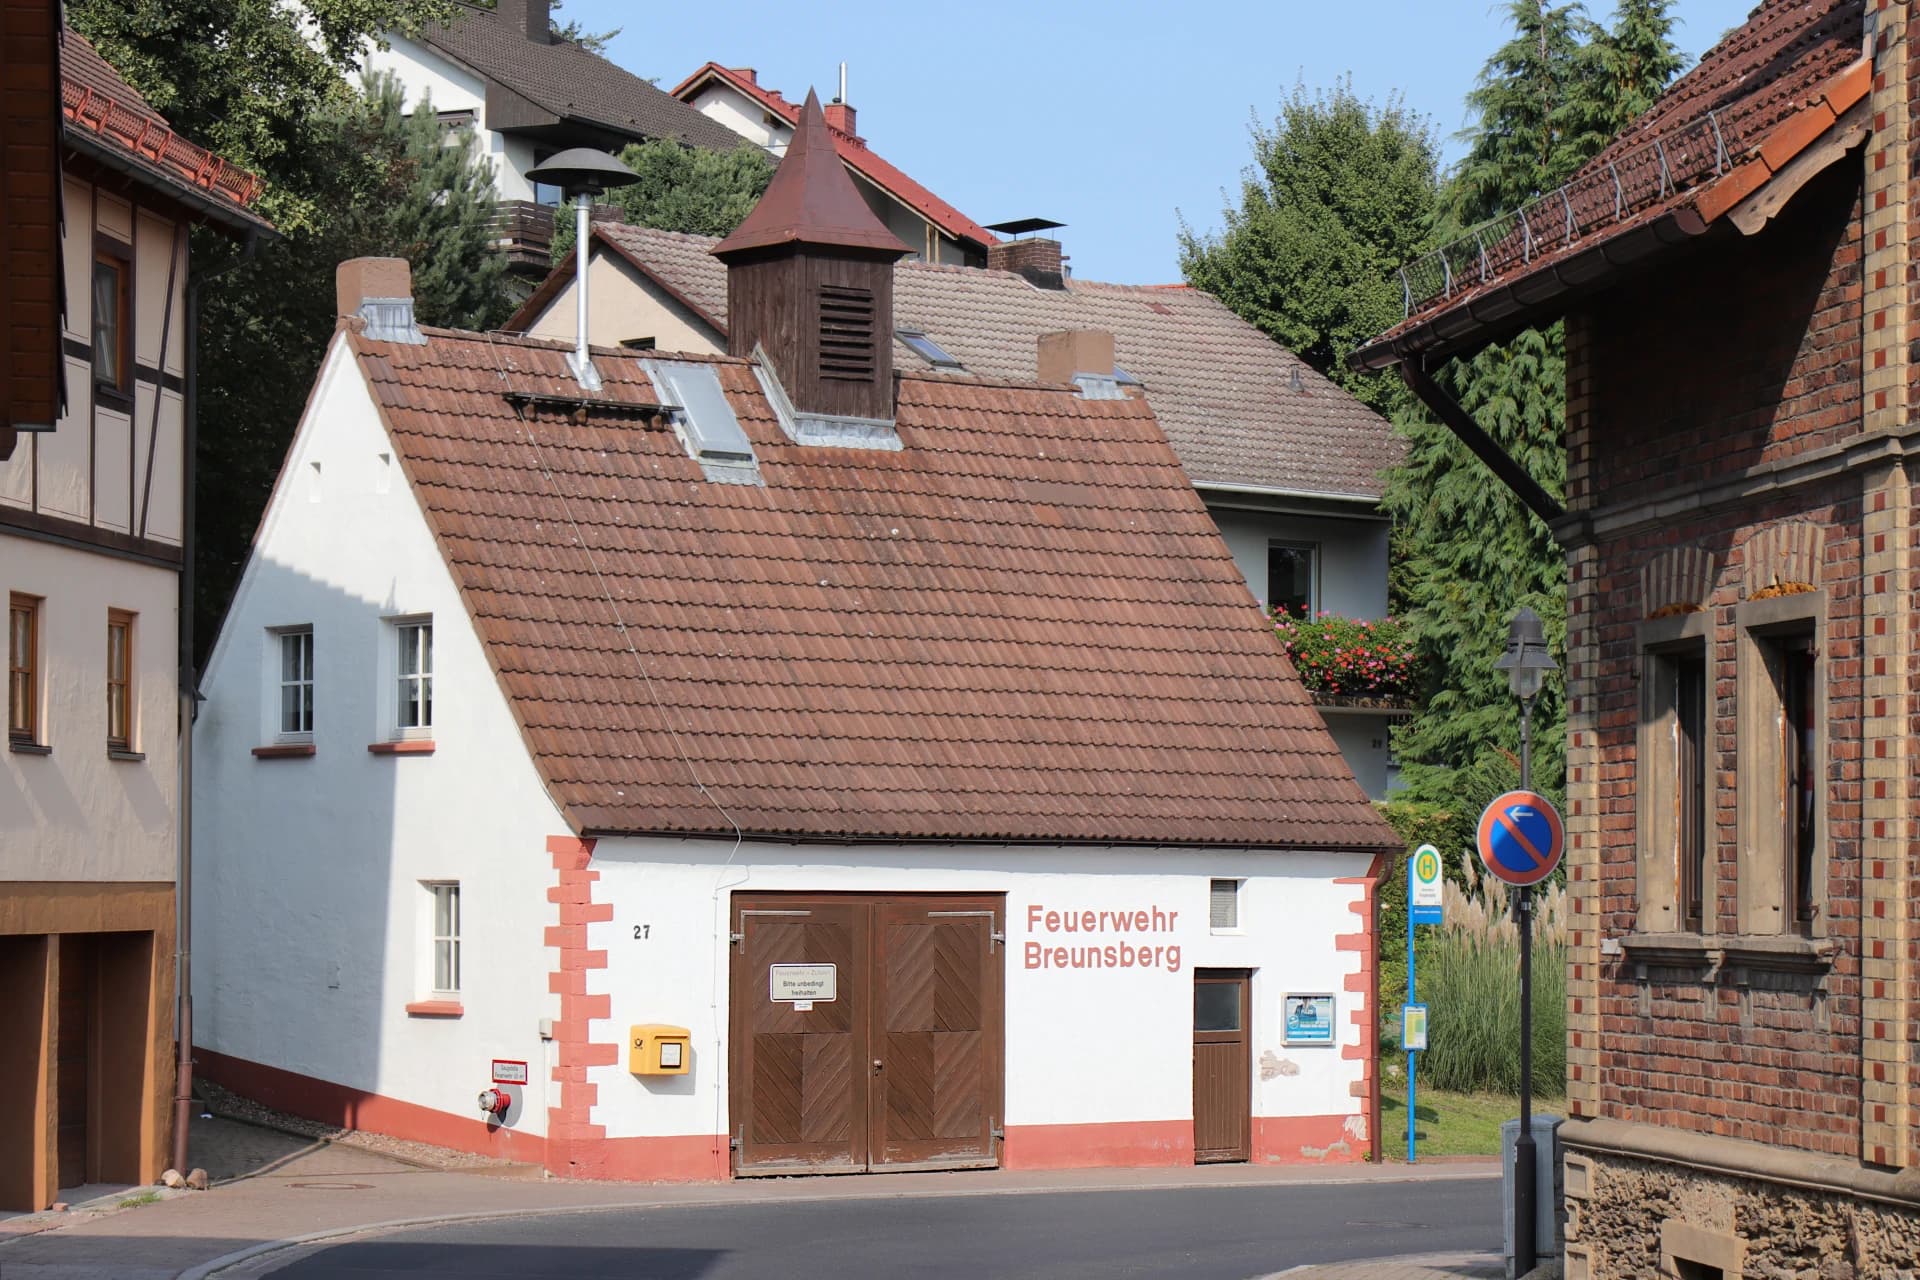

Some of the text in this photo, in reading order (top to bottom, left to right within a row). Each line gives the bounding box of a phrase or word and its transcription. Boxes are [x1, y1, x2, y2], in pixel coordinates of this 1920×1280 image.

[1423, 858, 1433, 876] H
[1027, 904, 1178, 933] Feuerwehr
[633, 924, 651, 940] 27
[1024, 940, 1181, 973] Breunsberg
